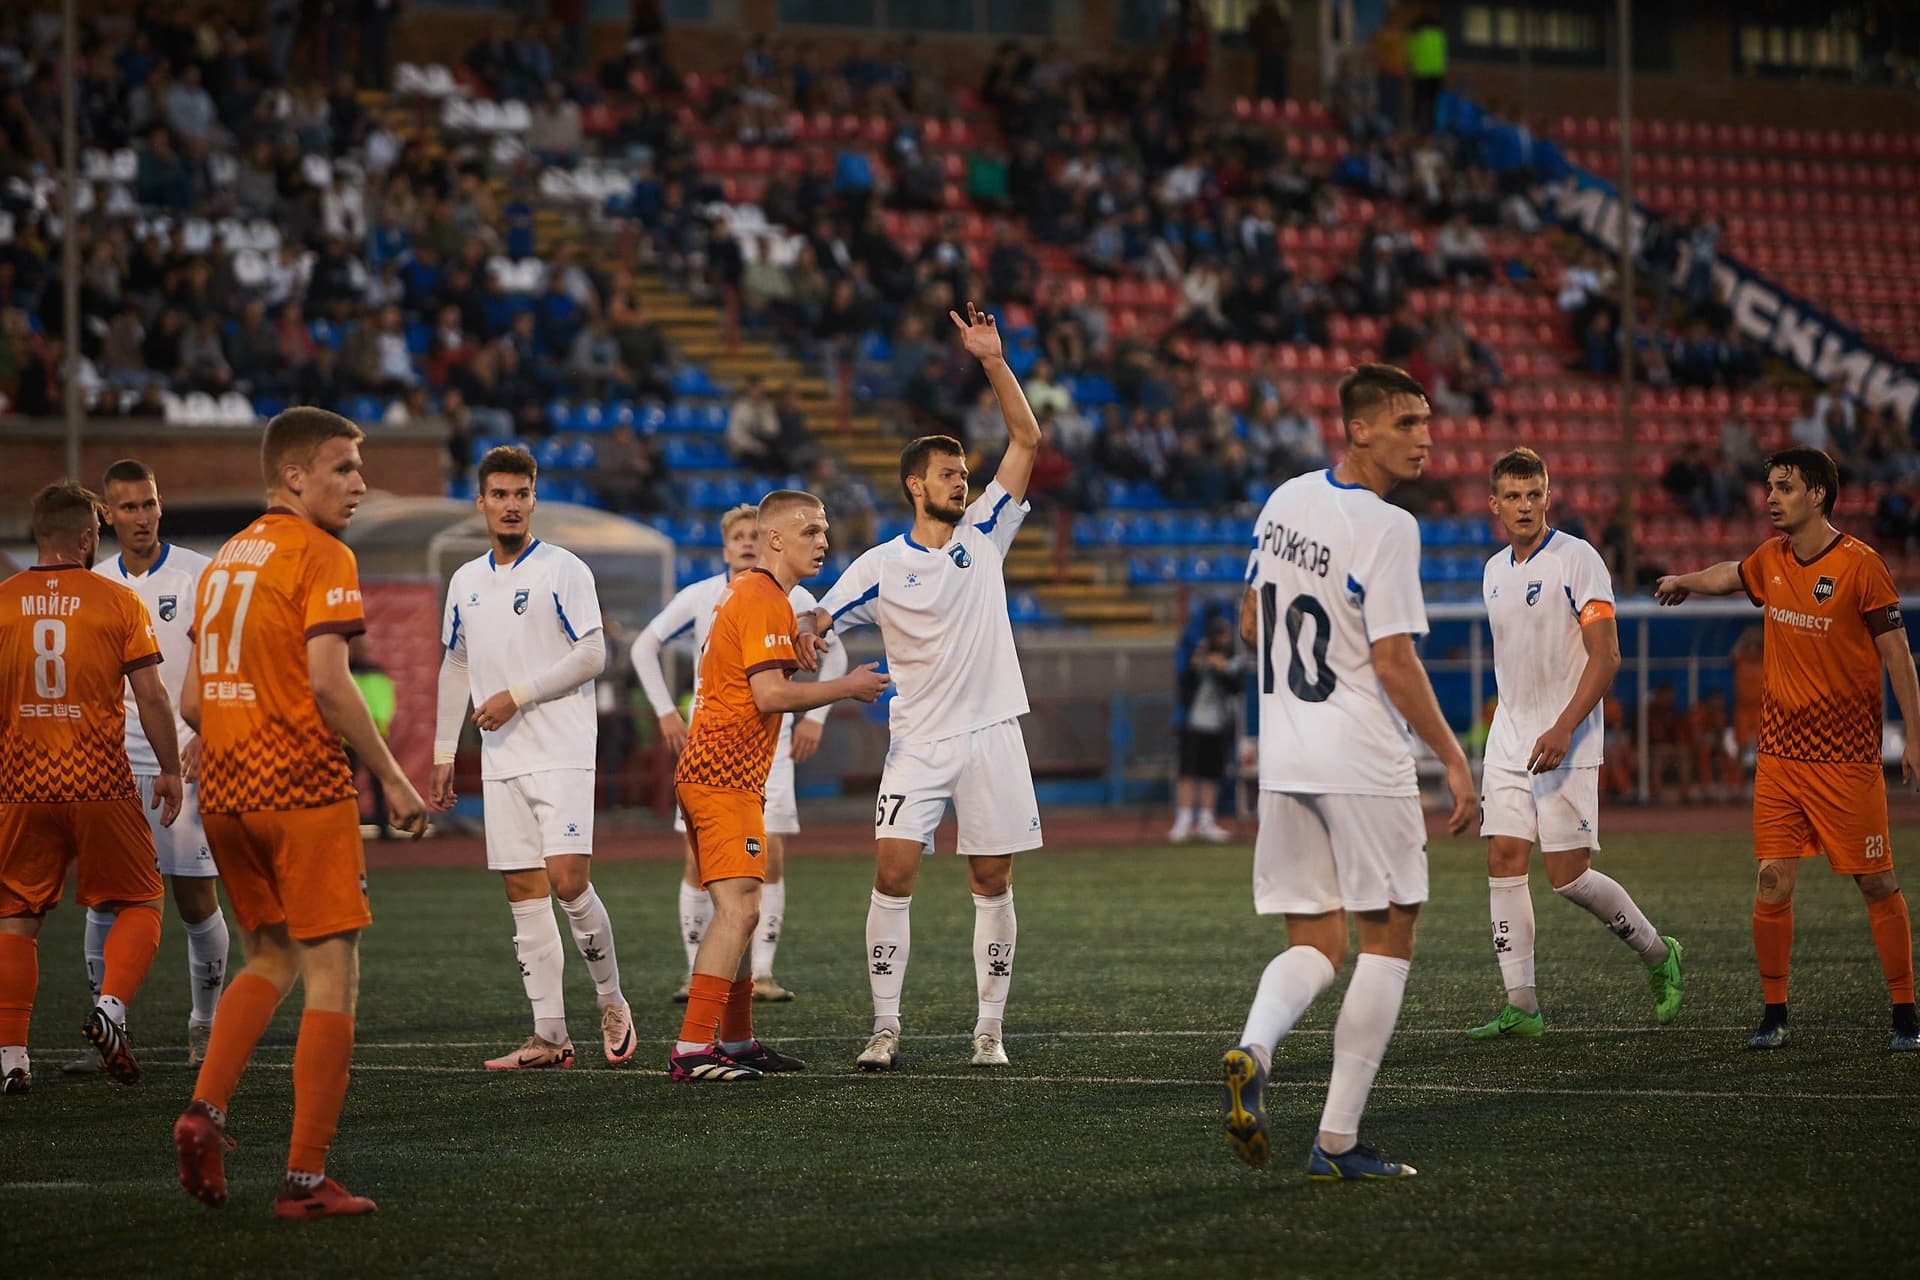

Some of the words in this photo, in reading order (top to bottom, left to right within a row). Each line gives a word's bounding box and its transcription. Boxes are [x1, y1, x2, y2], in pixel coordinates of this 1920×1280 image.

[21, 591, 81, 616] МАЙЕР
[200, 569, 258, 675] 27
[1261, 581, 1337, 703] 10
[33, 618, 66, 699] 8
[203, 681, 257, 700] EUS
[877, 794, 906, 827] 67
[1865, 834, 1883, 859] 23
[585, 933, 595, 946] 7
[1491, 920, 1509, 934] 15
[872, 945, 897, 959] 67
[988, 943, 1012, 957] 67
